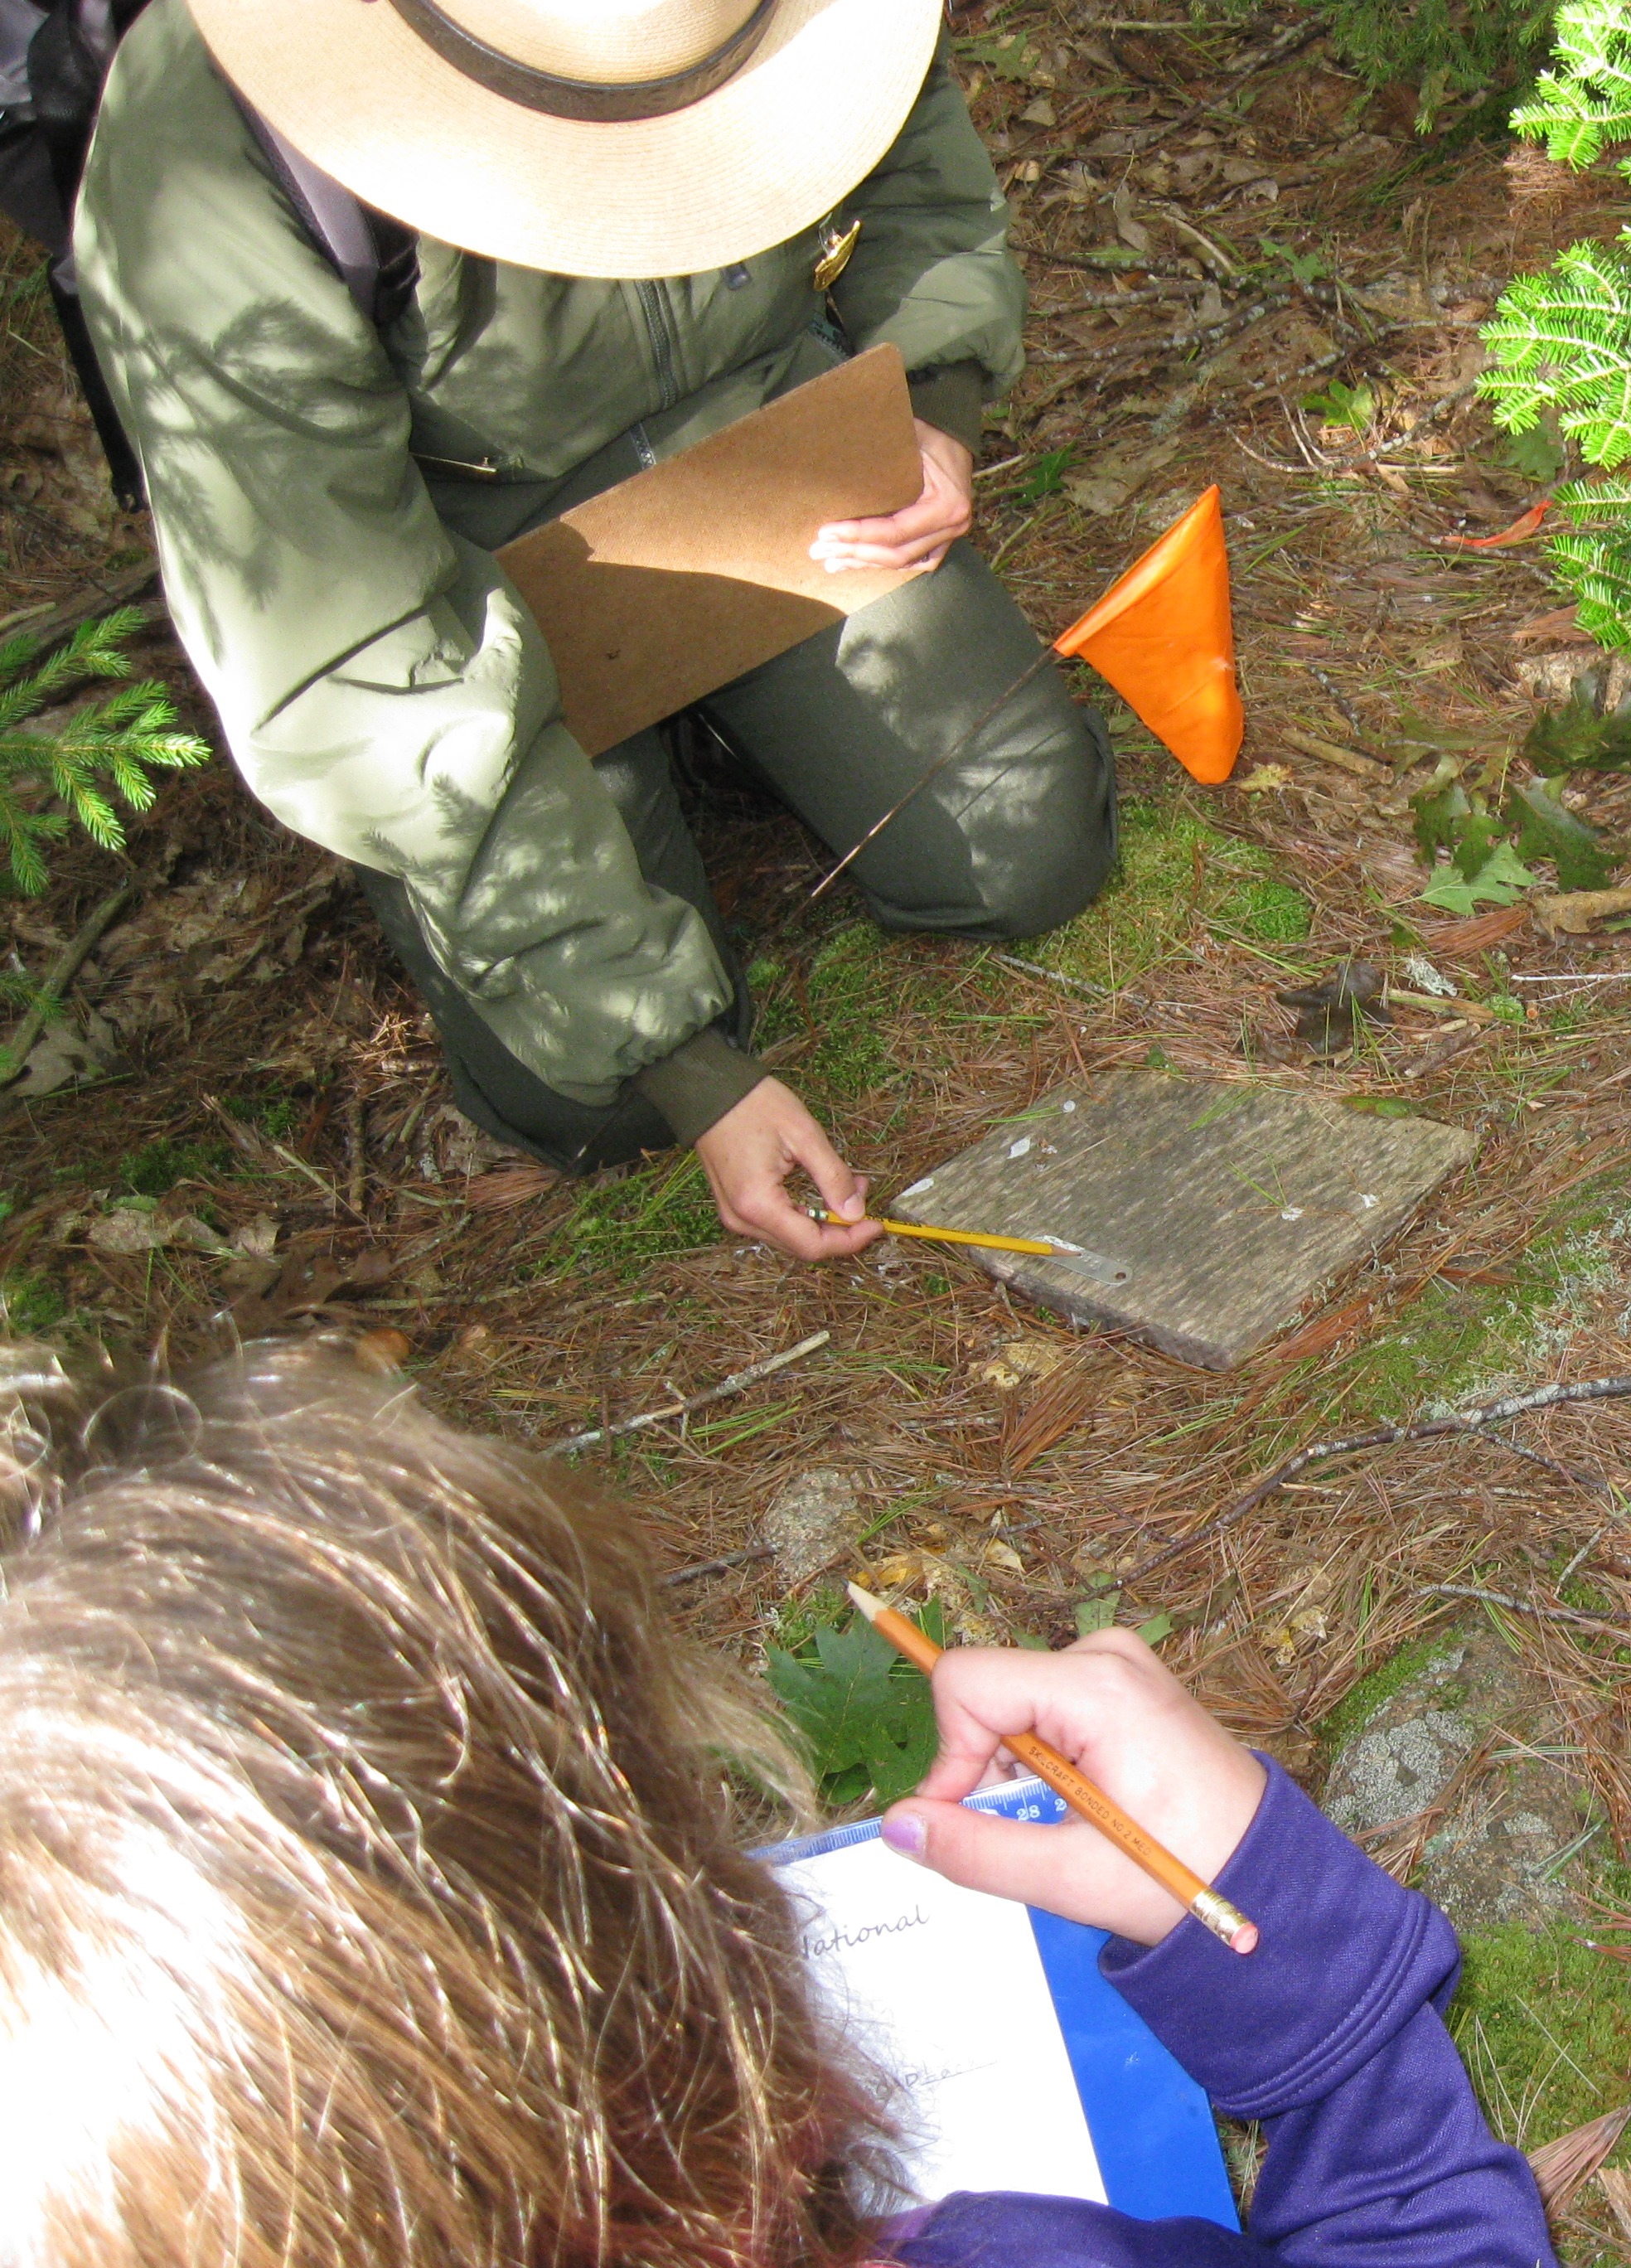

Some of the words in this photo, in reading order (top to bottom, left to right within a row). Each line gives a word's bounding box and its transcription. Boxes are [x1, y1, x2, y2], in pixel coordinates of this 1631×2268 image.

[1016, 1805, 1041, 1821] 28
[1074, 1787, 1111, 1820] BONDED
[1123, 1830, 1132, 1839] 2
